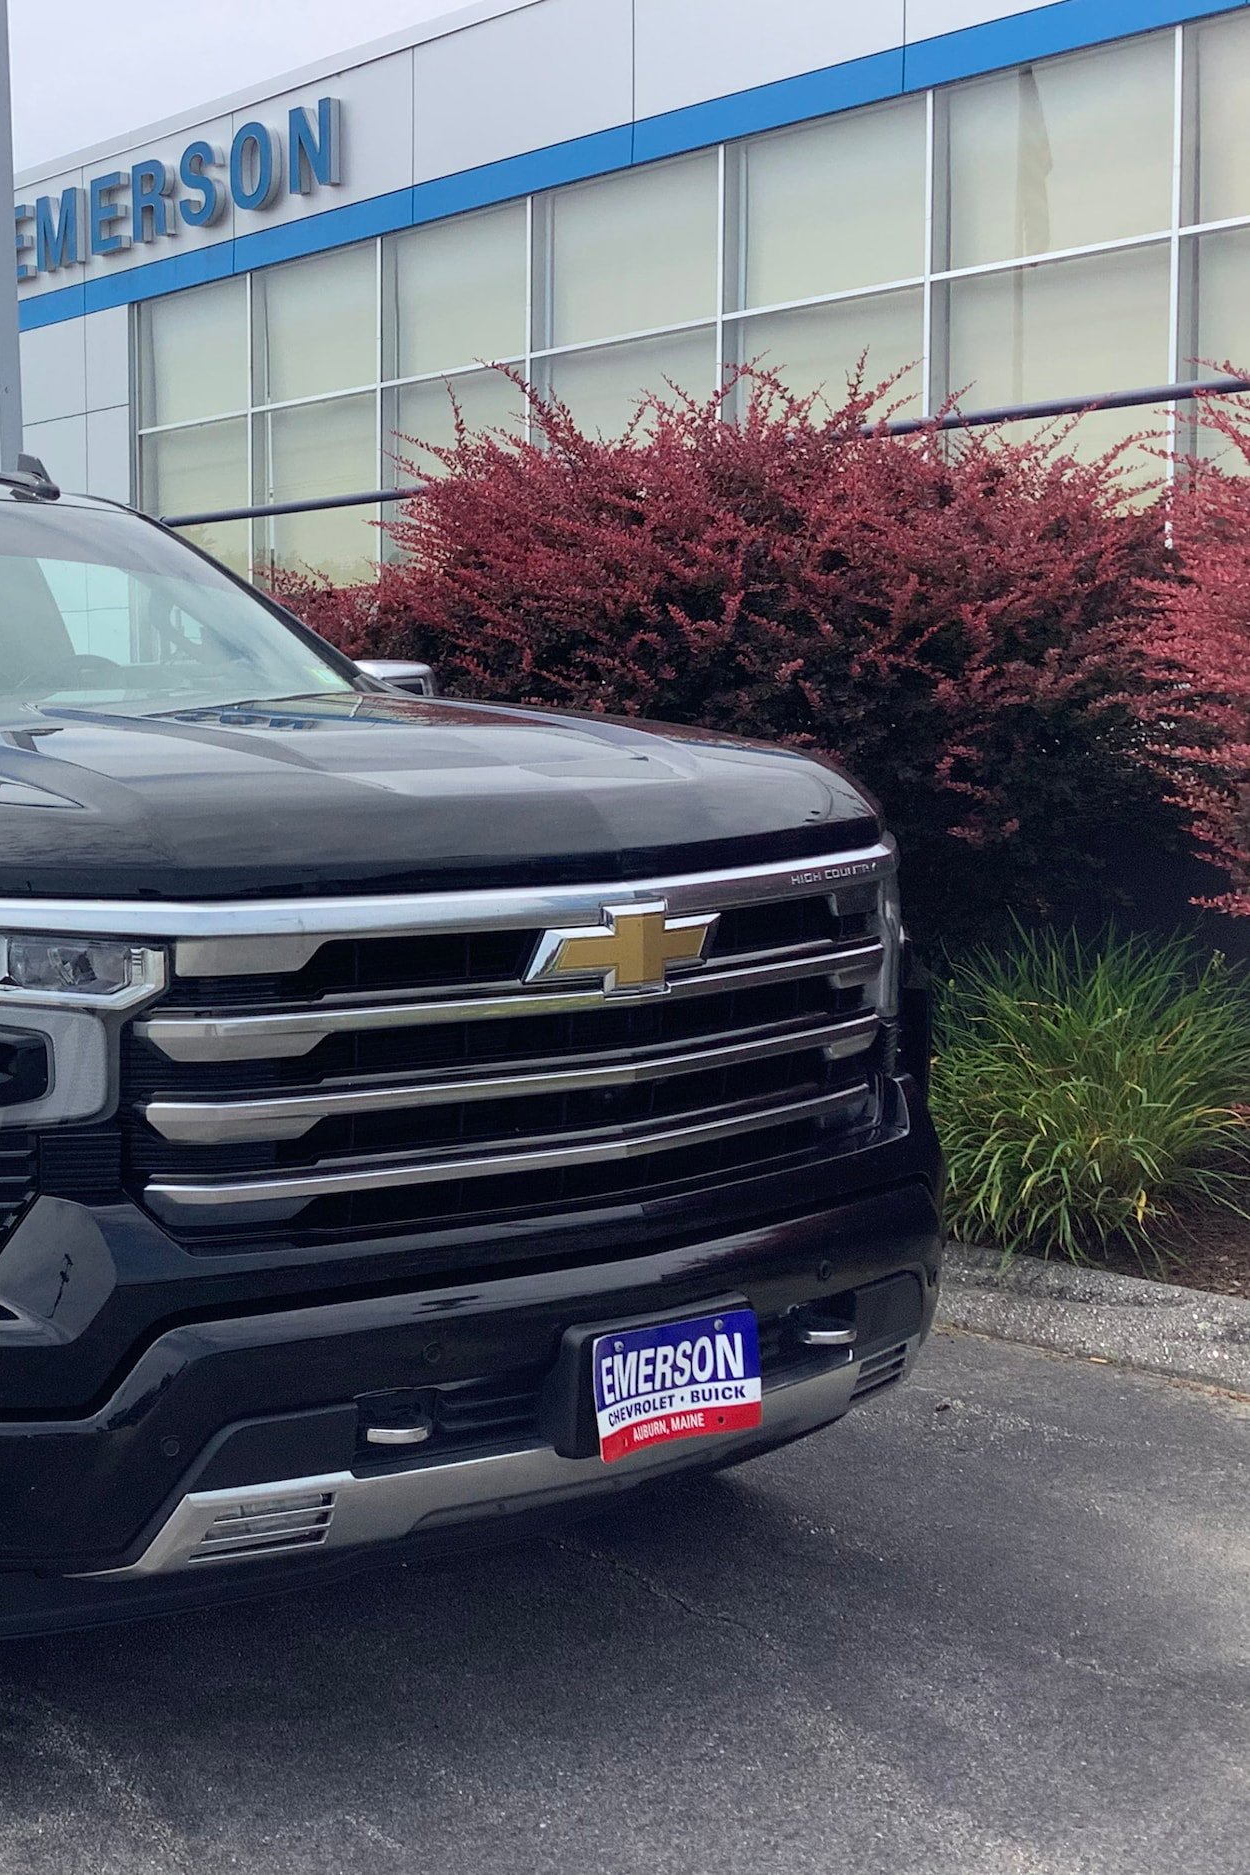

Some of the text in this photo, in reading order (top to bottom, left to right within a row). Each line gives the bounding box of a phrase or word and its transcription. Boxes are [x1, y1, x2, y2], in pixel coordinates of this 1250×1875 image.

[791, 862, 877, 885] HIGH COUNTRY
[601, 1332, 745, 1406] EMERSON
[608, 1385, 746, 1428] CHEVROLET BUICK
[633, 1412, 706, 1443] AUBURN, MAINE
